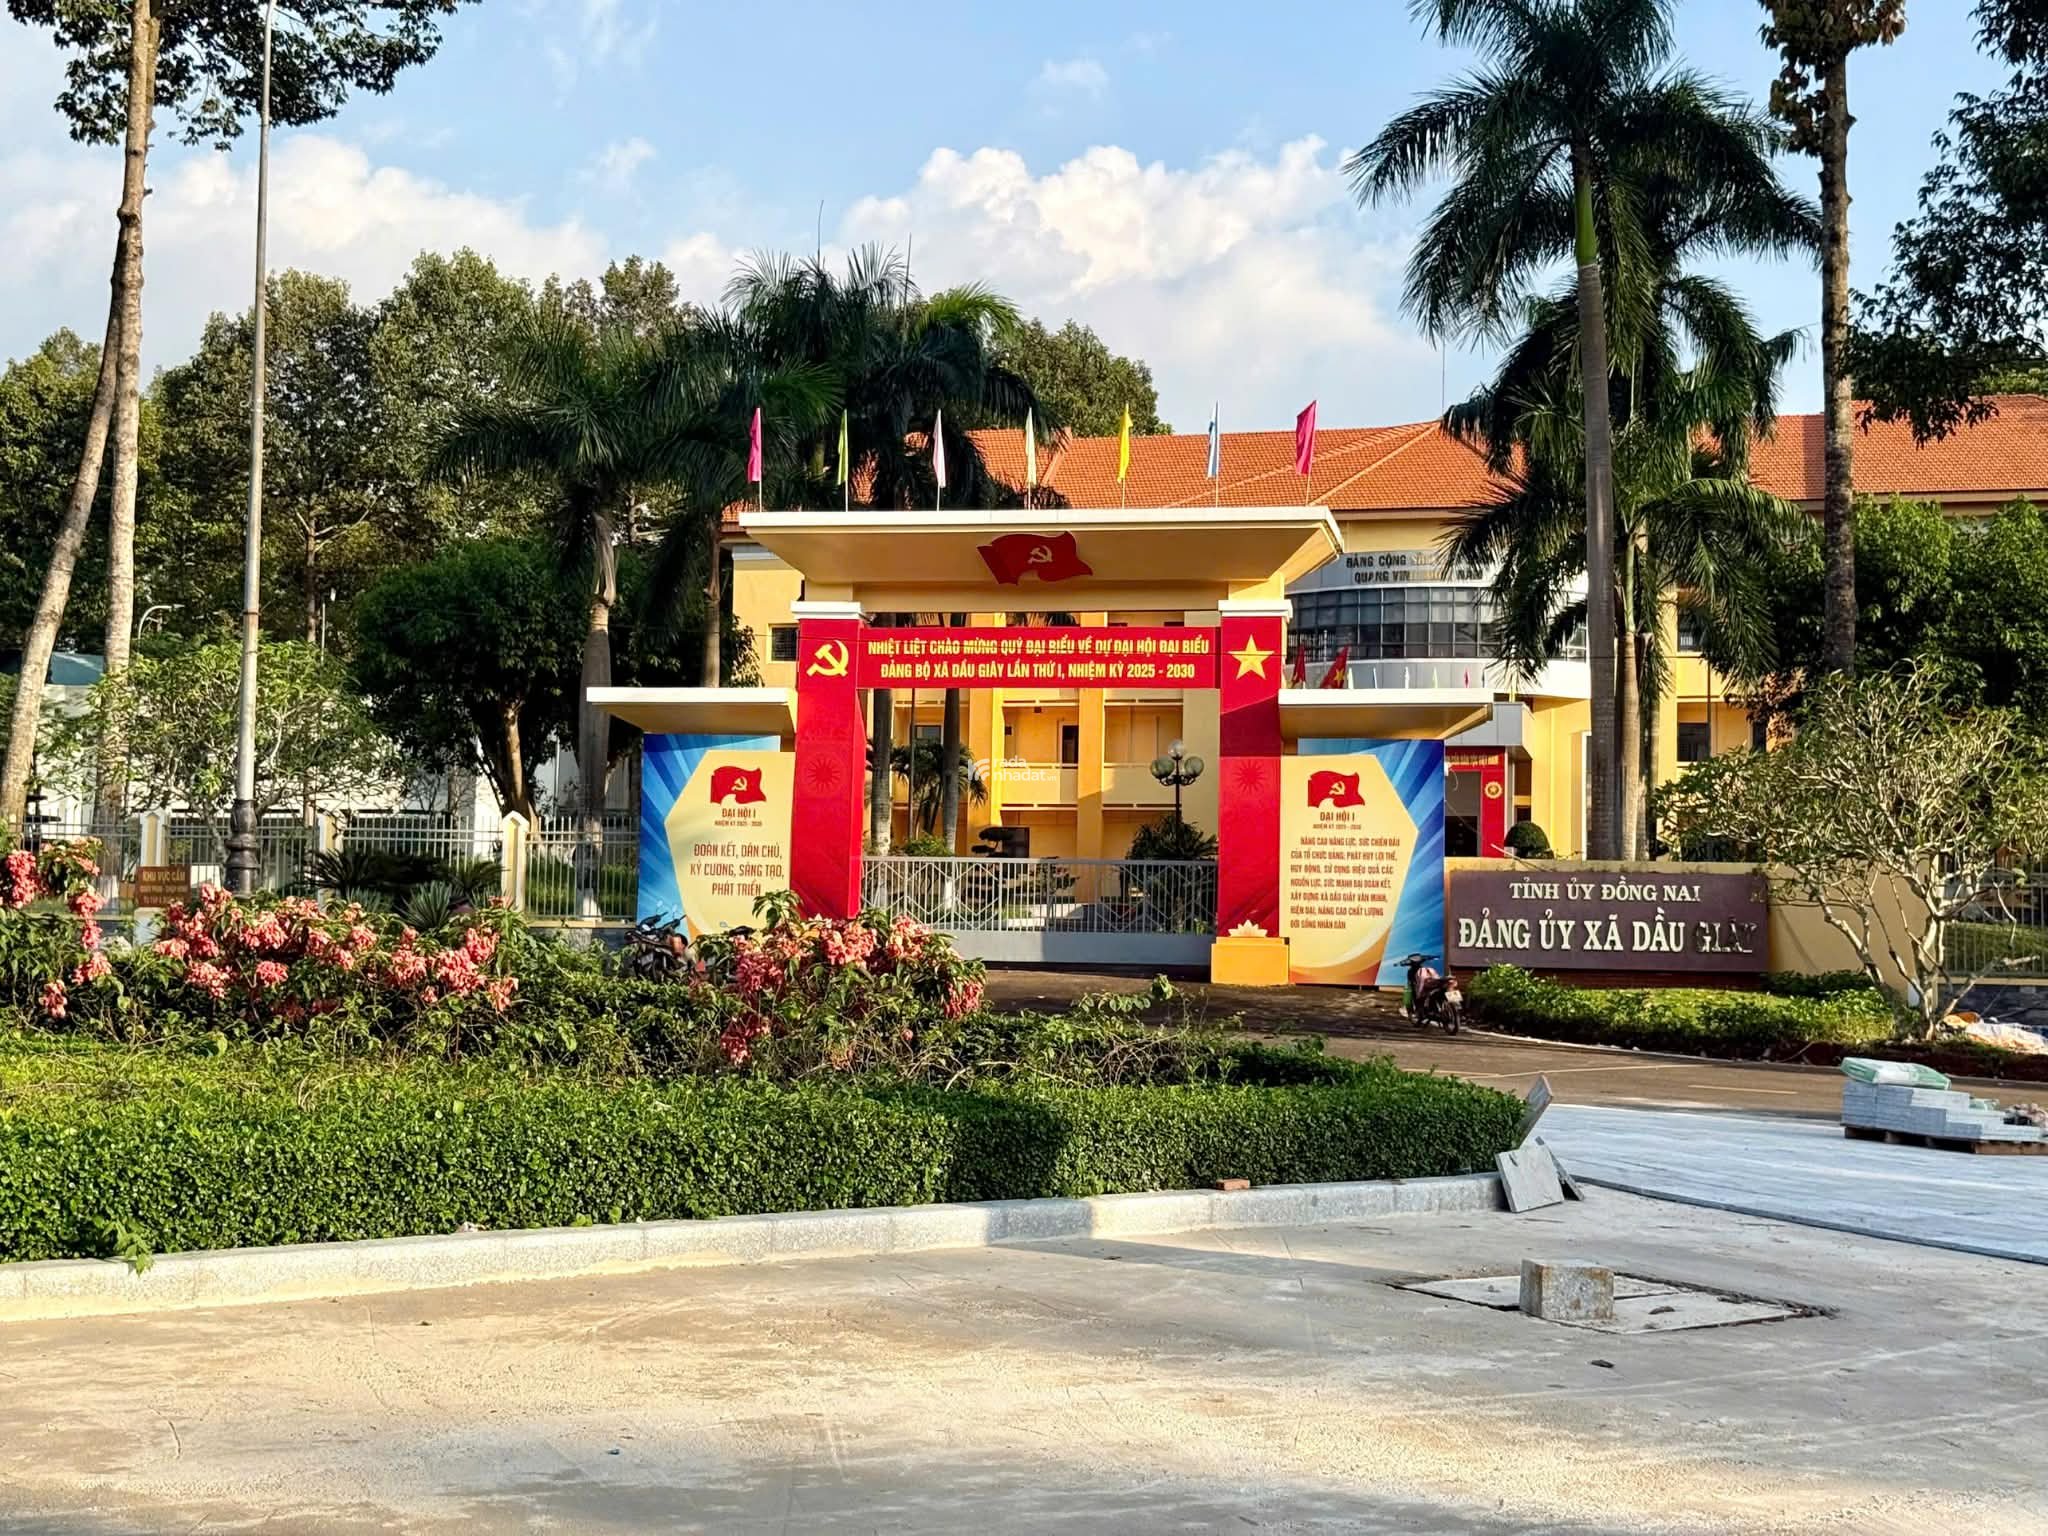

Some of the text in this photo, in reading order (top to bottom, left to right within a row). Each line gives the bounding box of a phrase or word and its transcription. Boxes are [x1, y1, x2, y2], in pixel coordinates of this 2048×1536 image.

[1378, 553, 1407, 568] CỘNG
[868, 637, 901, 657] NHIỆT
[904, 637, 927, 657] LIỆT
[929, 637, 960, 655] CHÀO
[963, 637, 998, 655] MỪNG
[1026, 640, 1046, 657] ĐẠI
[1049, 634, 1075, 654] BIỂU
[1078, 635, 1093, 654] VỀ
[1096, 639, 1113, 657] DỰ
[1114, 640, 1134, 657] ĐẠI
[1137, 637, 1157, 657] HỘI
[1160, 640, 1179, 657] ĐẠI
[1182, 634, 1209, 654] BIỂU
[881, 659, 912, 678] ĐẢNG
[915, 660, 931, 680] BỘ
[933, 661, 950, 678] XÃ
[1033, 660, 1056, 678] THỨ
[1057, 664, 1065, 680] I,
[1068, 660, 1106, 680] NHIỆM
[1109, 660, 1125, 678] KỲ
[1127, 663, 1155, 678] 2025
[1166, 663, 1195, 678] 2030
[722, 808, 736, 818] ĐẠI
[737, 807, 751, 819] HỘI
[1320, 811, 1334, 822] ĐẠI
[1336, 811, 1350, 822] HỘI
[694, 841, 718, 857] ĐOÀN
[721, 840, 739, 859] KẾT,
[765, 864, 784, 880] TẠO,
[712, 880, 735, 896] PHÁT
[1509, 875, 1702, 902] TỈNH ỦY ĐỒNG NAI
[1458, 907, 1532, 949] ĐẢNG
[1539, 908, 1576, 950] ỦY
[1583, 913, 1624, 951] XÃ
[1632, 906, 1686, 952] DẦU
